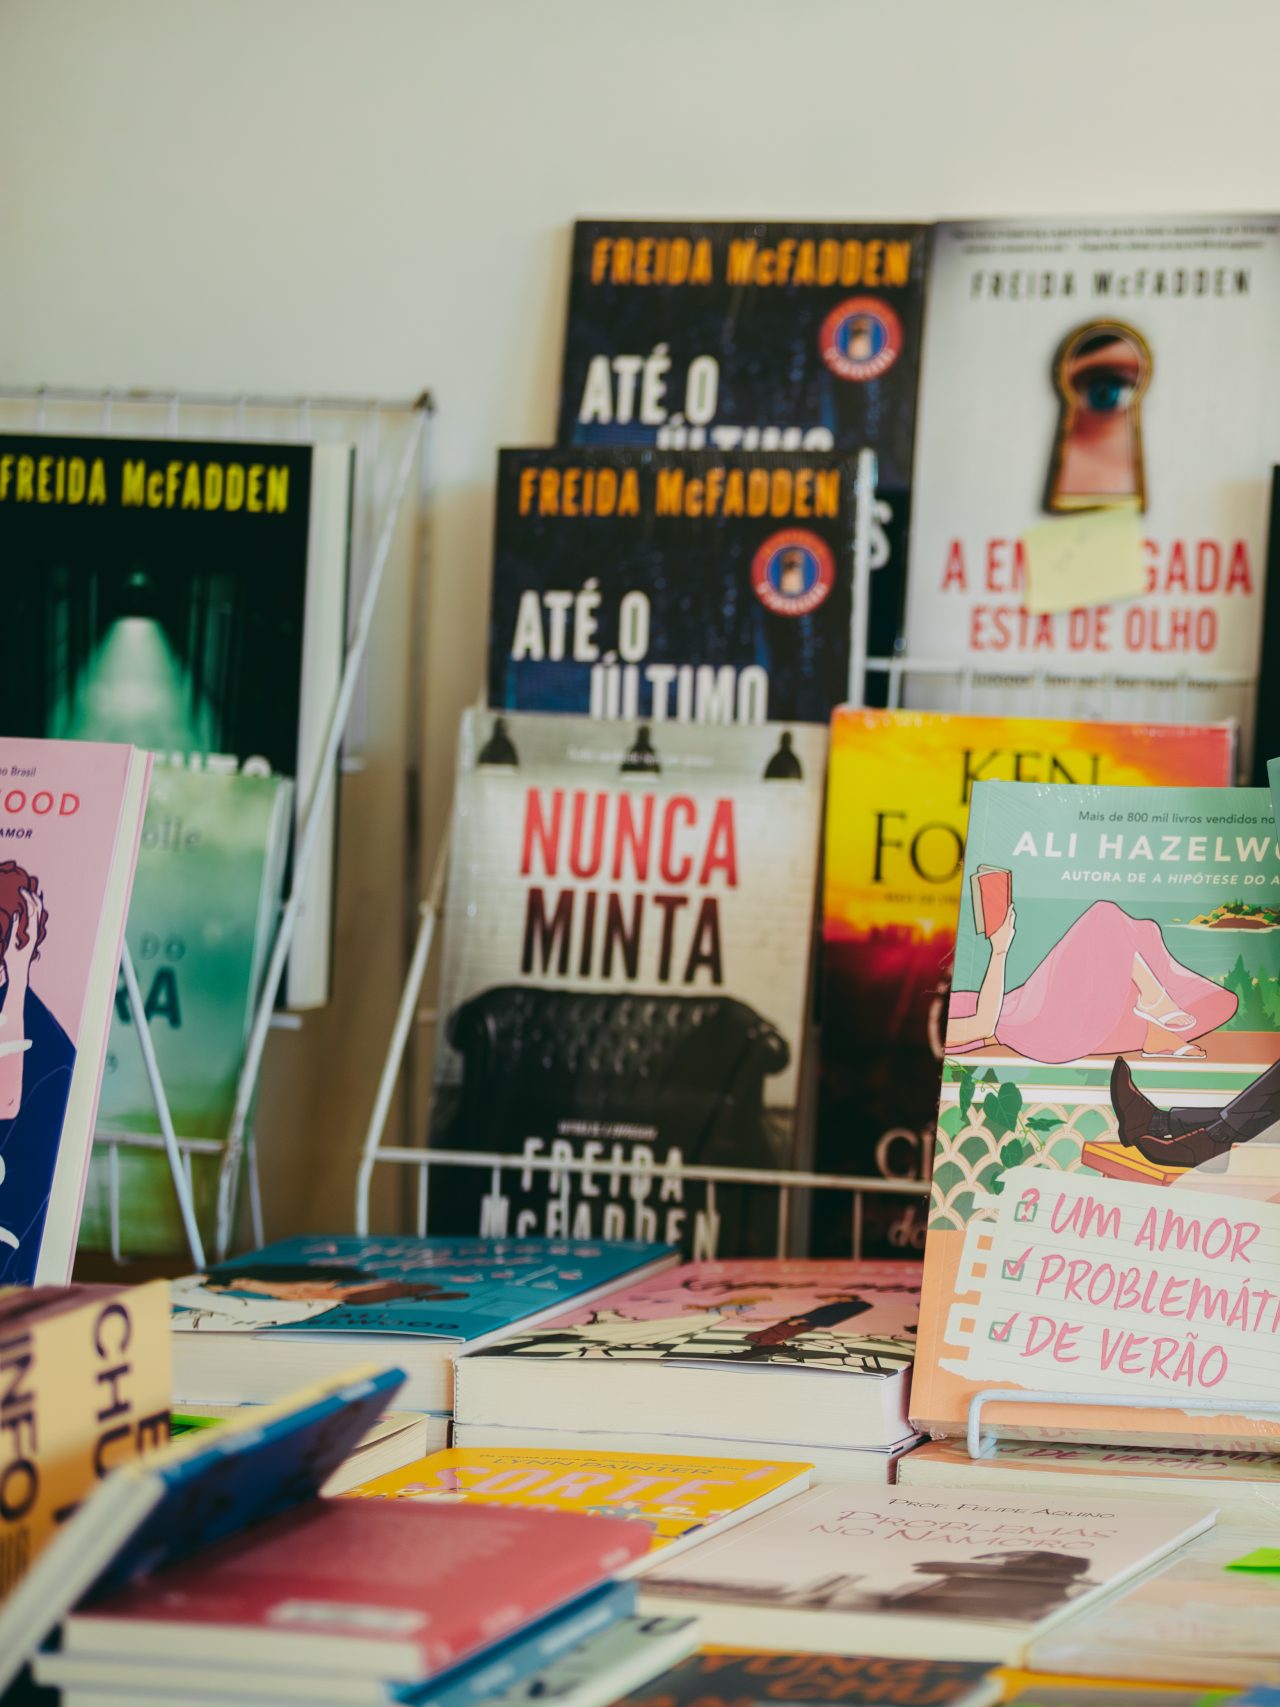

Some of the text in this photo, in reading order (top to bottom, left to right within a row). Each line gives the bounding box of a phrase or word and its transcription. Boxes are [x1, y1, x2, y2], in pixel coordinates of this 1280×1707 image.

[591, 238, 911, 286] FREIDA McFADDEN
[971, 270, 1251, 299] FREIDA McFADDEN
[579, 342, 719, 425] ATÉ O
[0, 454, 291, 514] FREIDA McFADDEN
[519, 468, 841, 518] FREIDA McFADDEN
[941, 537, 1254, 594] A EGADA
[511, 578, 650, 662] ATÉ O
[1068, 606, 1114, 653] DE
[1124, 606, 1218, 655] OLHO
[0, 788, 80, 816] OOD
[1078, 810, 1105, 822] Mais
[1109, 811, 1123, 822] de
[1127, 812, 1148, 823] 800
[1151, 812, 1168, 823] mil
[1172, 813, 1202, 824] livros
[1206, 814, 1257, 825] vendidos
[519, 785, 738, 888] NUNCA
[1012, 831, 1078, 859] ALI
[1098, 833, 1280, 863] HAZELW
[1061, 870, 1121, 882] AUTORA
[1127, 872, 1147, 883] DE
[1151, 873, 1161, 883] A
[1167, 871, 1238, 885] HIPÓTESE
[1244, 874, 1265, 885] DO
[520, 887, 723, 985] MINTA
[1050, 1192, 1121, 1240] UM
[1134, 1206, 1262, 1264] AMOR
[1019, 1315, 1229, 1388] DE VERÃO
[405, 1466, 737, 1507] SORTE
[491, 1457, 578, 1469] LYNN
[579, 1461, 713, 1477] PAINTER
